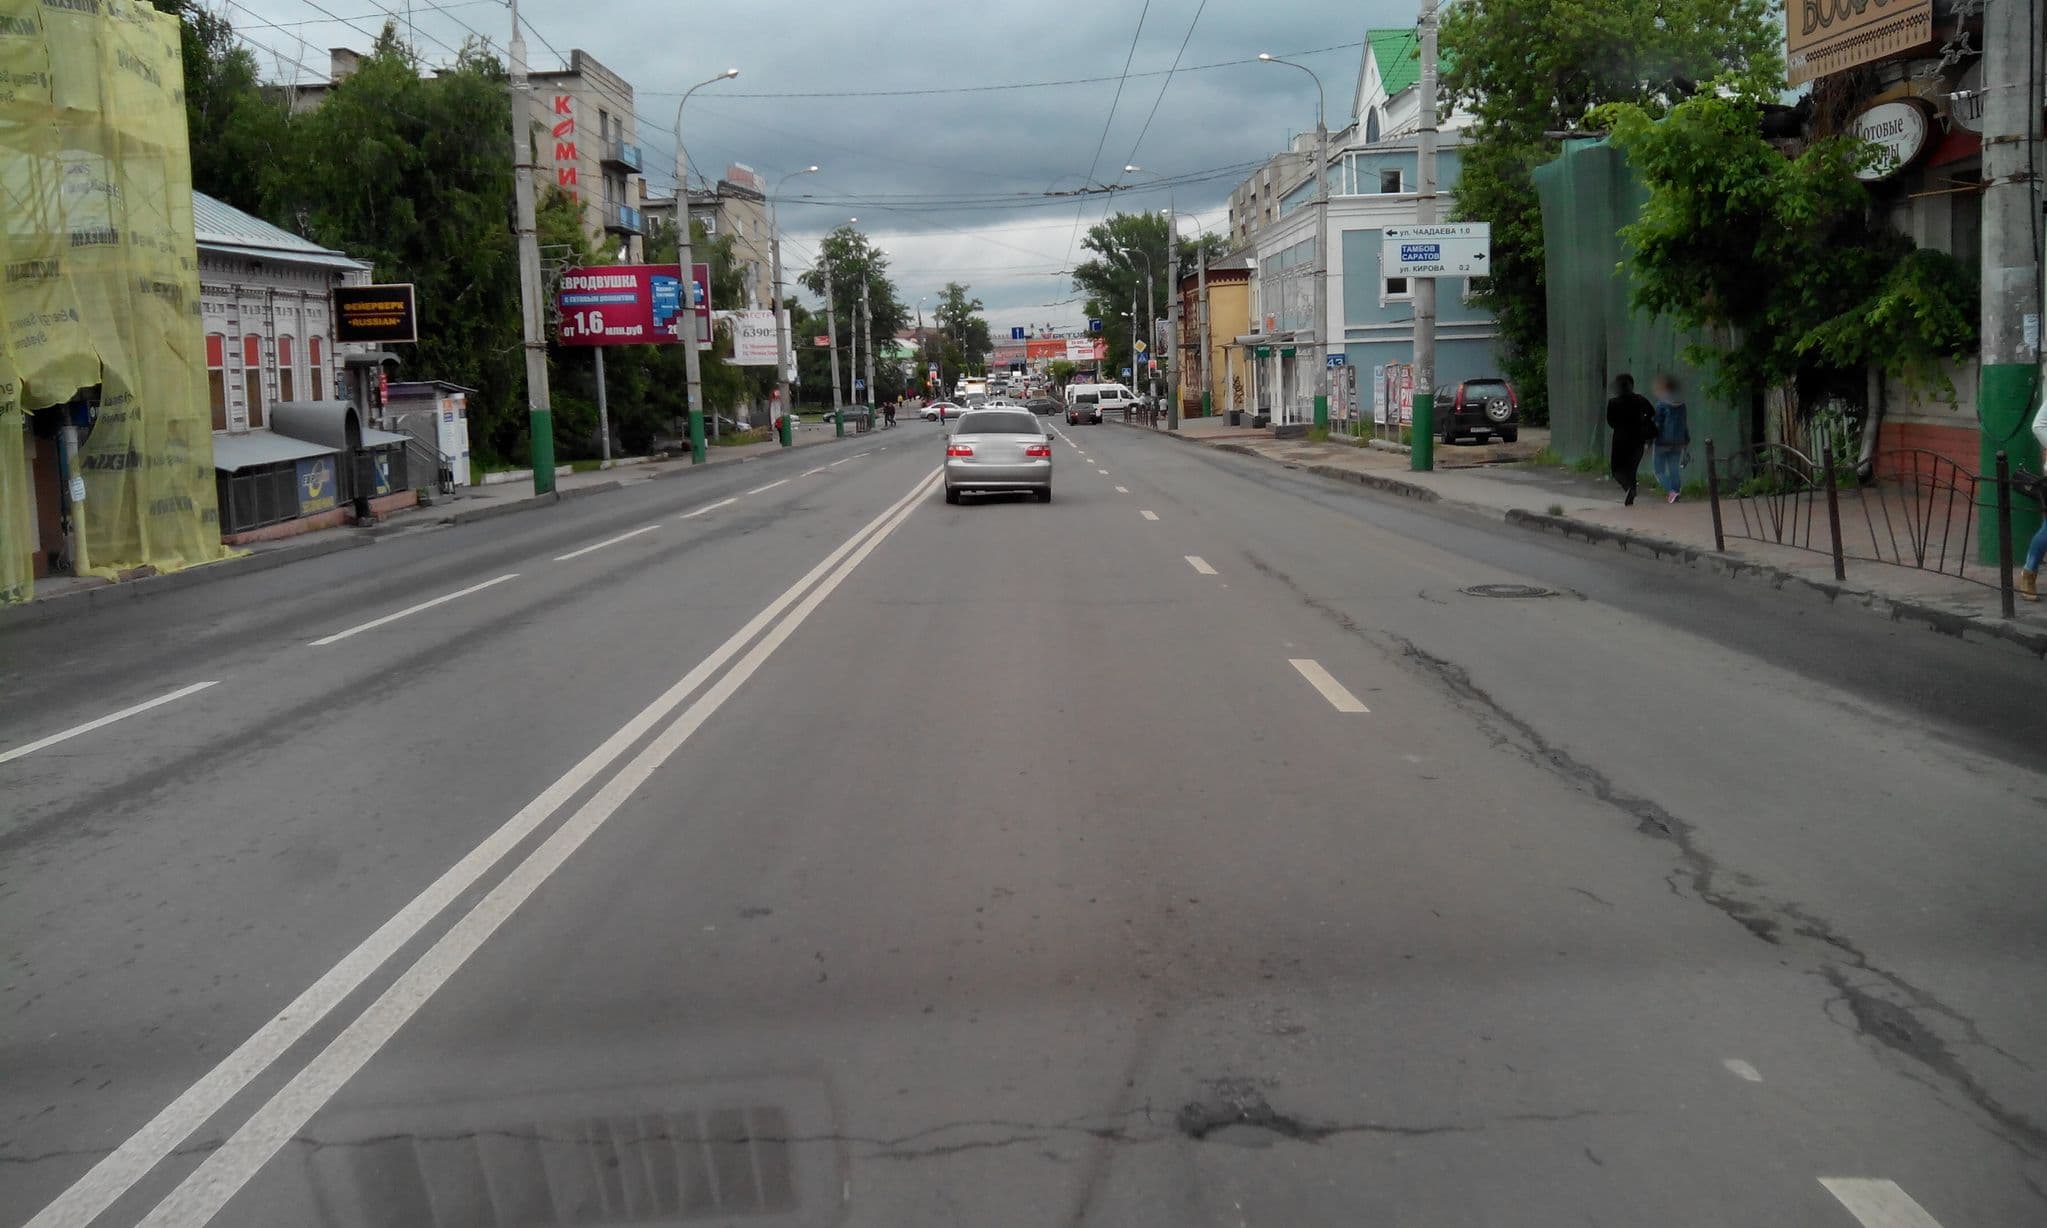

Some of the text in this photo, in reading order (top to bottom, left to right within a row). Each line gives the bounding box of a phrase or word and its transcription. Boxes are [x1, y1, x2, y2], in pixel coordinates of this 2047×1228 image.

[1402, 245, 1436, 253] ТАМБОВ
[1401, 253, 1440, 261] САРАТОВ
[564, 327, 574, 336] от
[574, 311, 604, 336] 1,6
[743, 328, 770, 337] 6390
